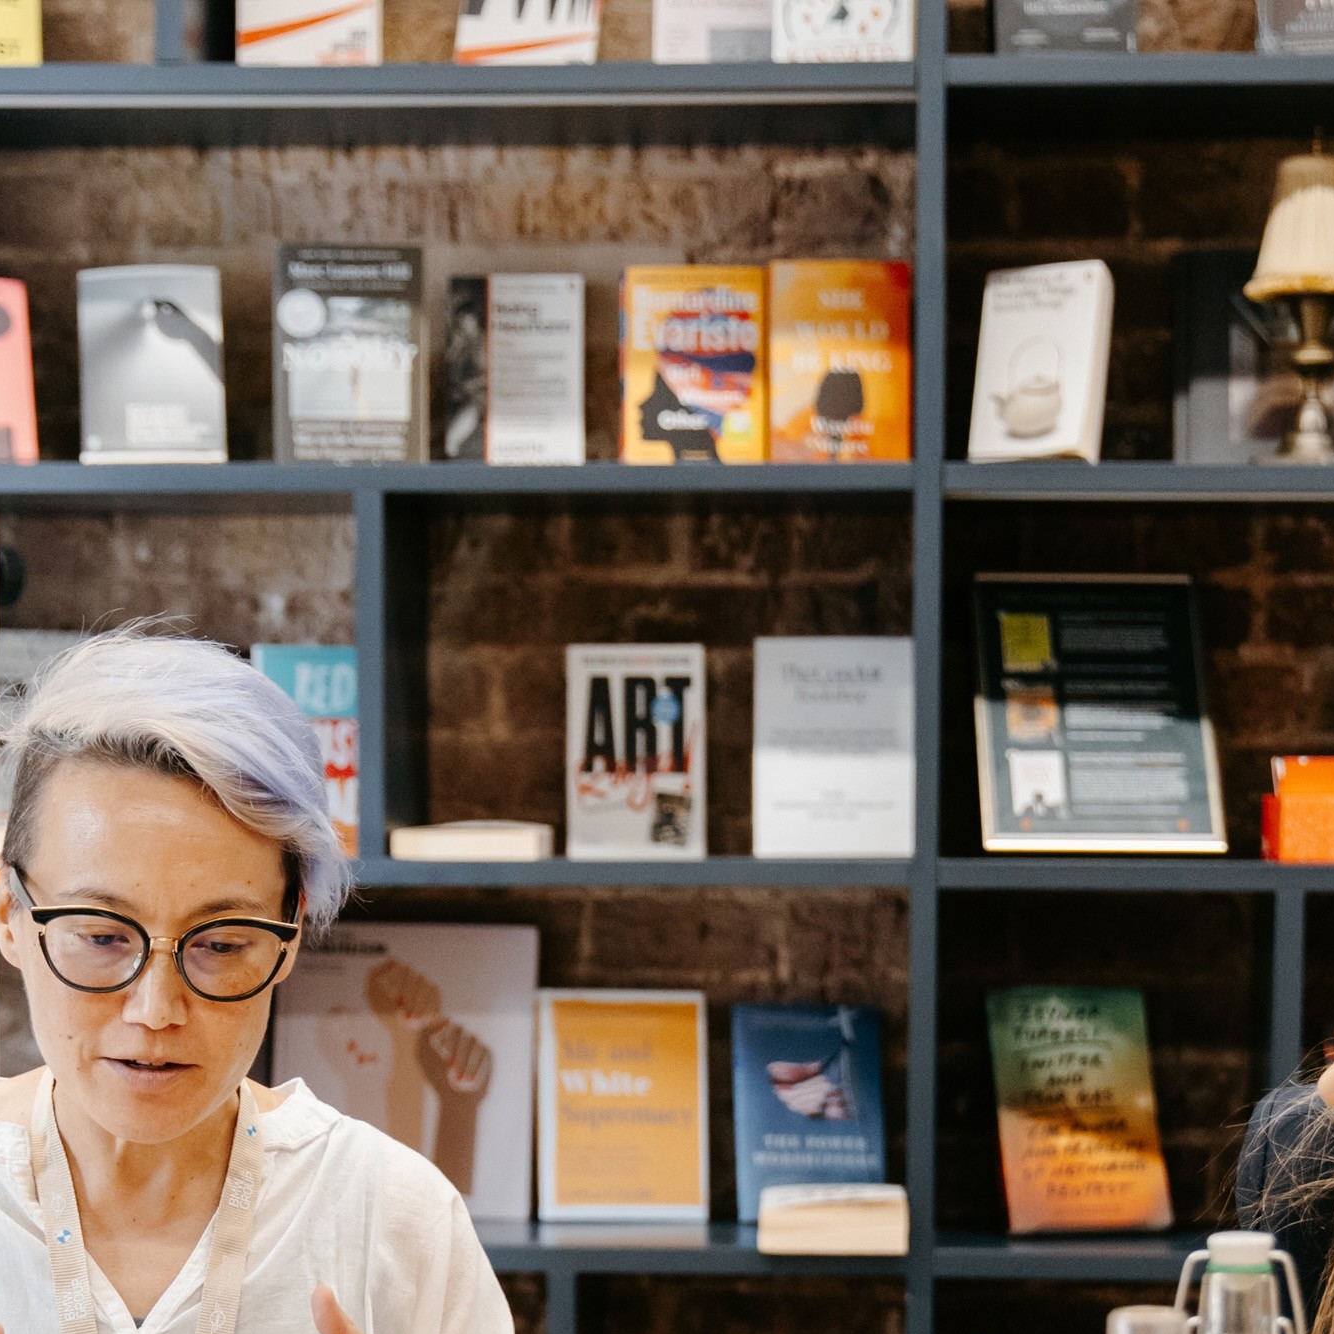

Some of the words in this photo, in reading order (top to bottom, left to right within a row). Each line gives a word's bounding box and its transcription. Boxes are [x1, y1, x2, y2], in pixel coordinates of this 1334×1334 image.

[632, 317, 759, 352] Evaristo
[584, 677, 692, 773] ART
[560, 1068, 652, 1097] White
[229, 1178, 244, 1208] BMW
[240, 1171, 255, 1210] GROUP
[64, 1290, 75, 1321] BMW
[71, 1278, 87, 1319] GROUP
